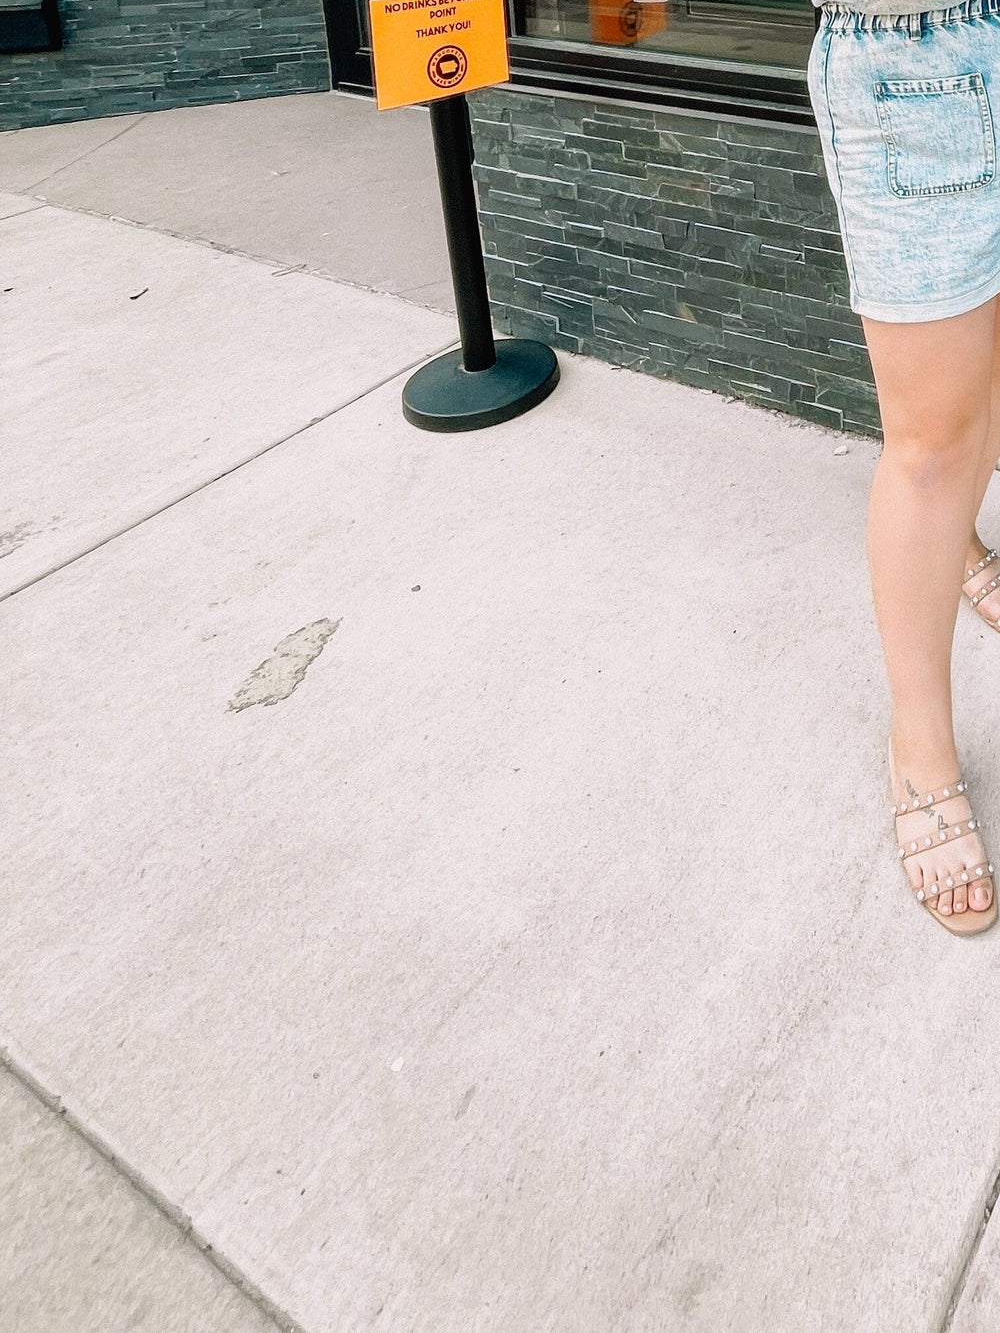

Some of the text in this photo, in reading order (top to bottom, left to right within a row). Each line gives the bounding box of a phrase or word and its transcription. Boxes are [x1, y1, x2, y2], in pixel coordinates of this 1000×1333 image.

[384, 3, 401, 14] NO
[429, 6, 457, 19] POINT
[416, 19, 472, 38] THANK YOU!
